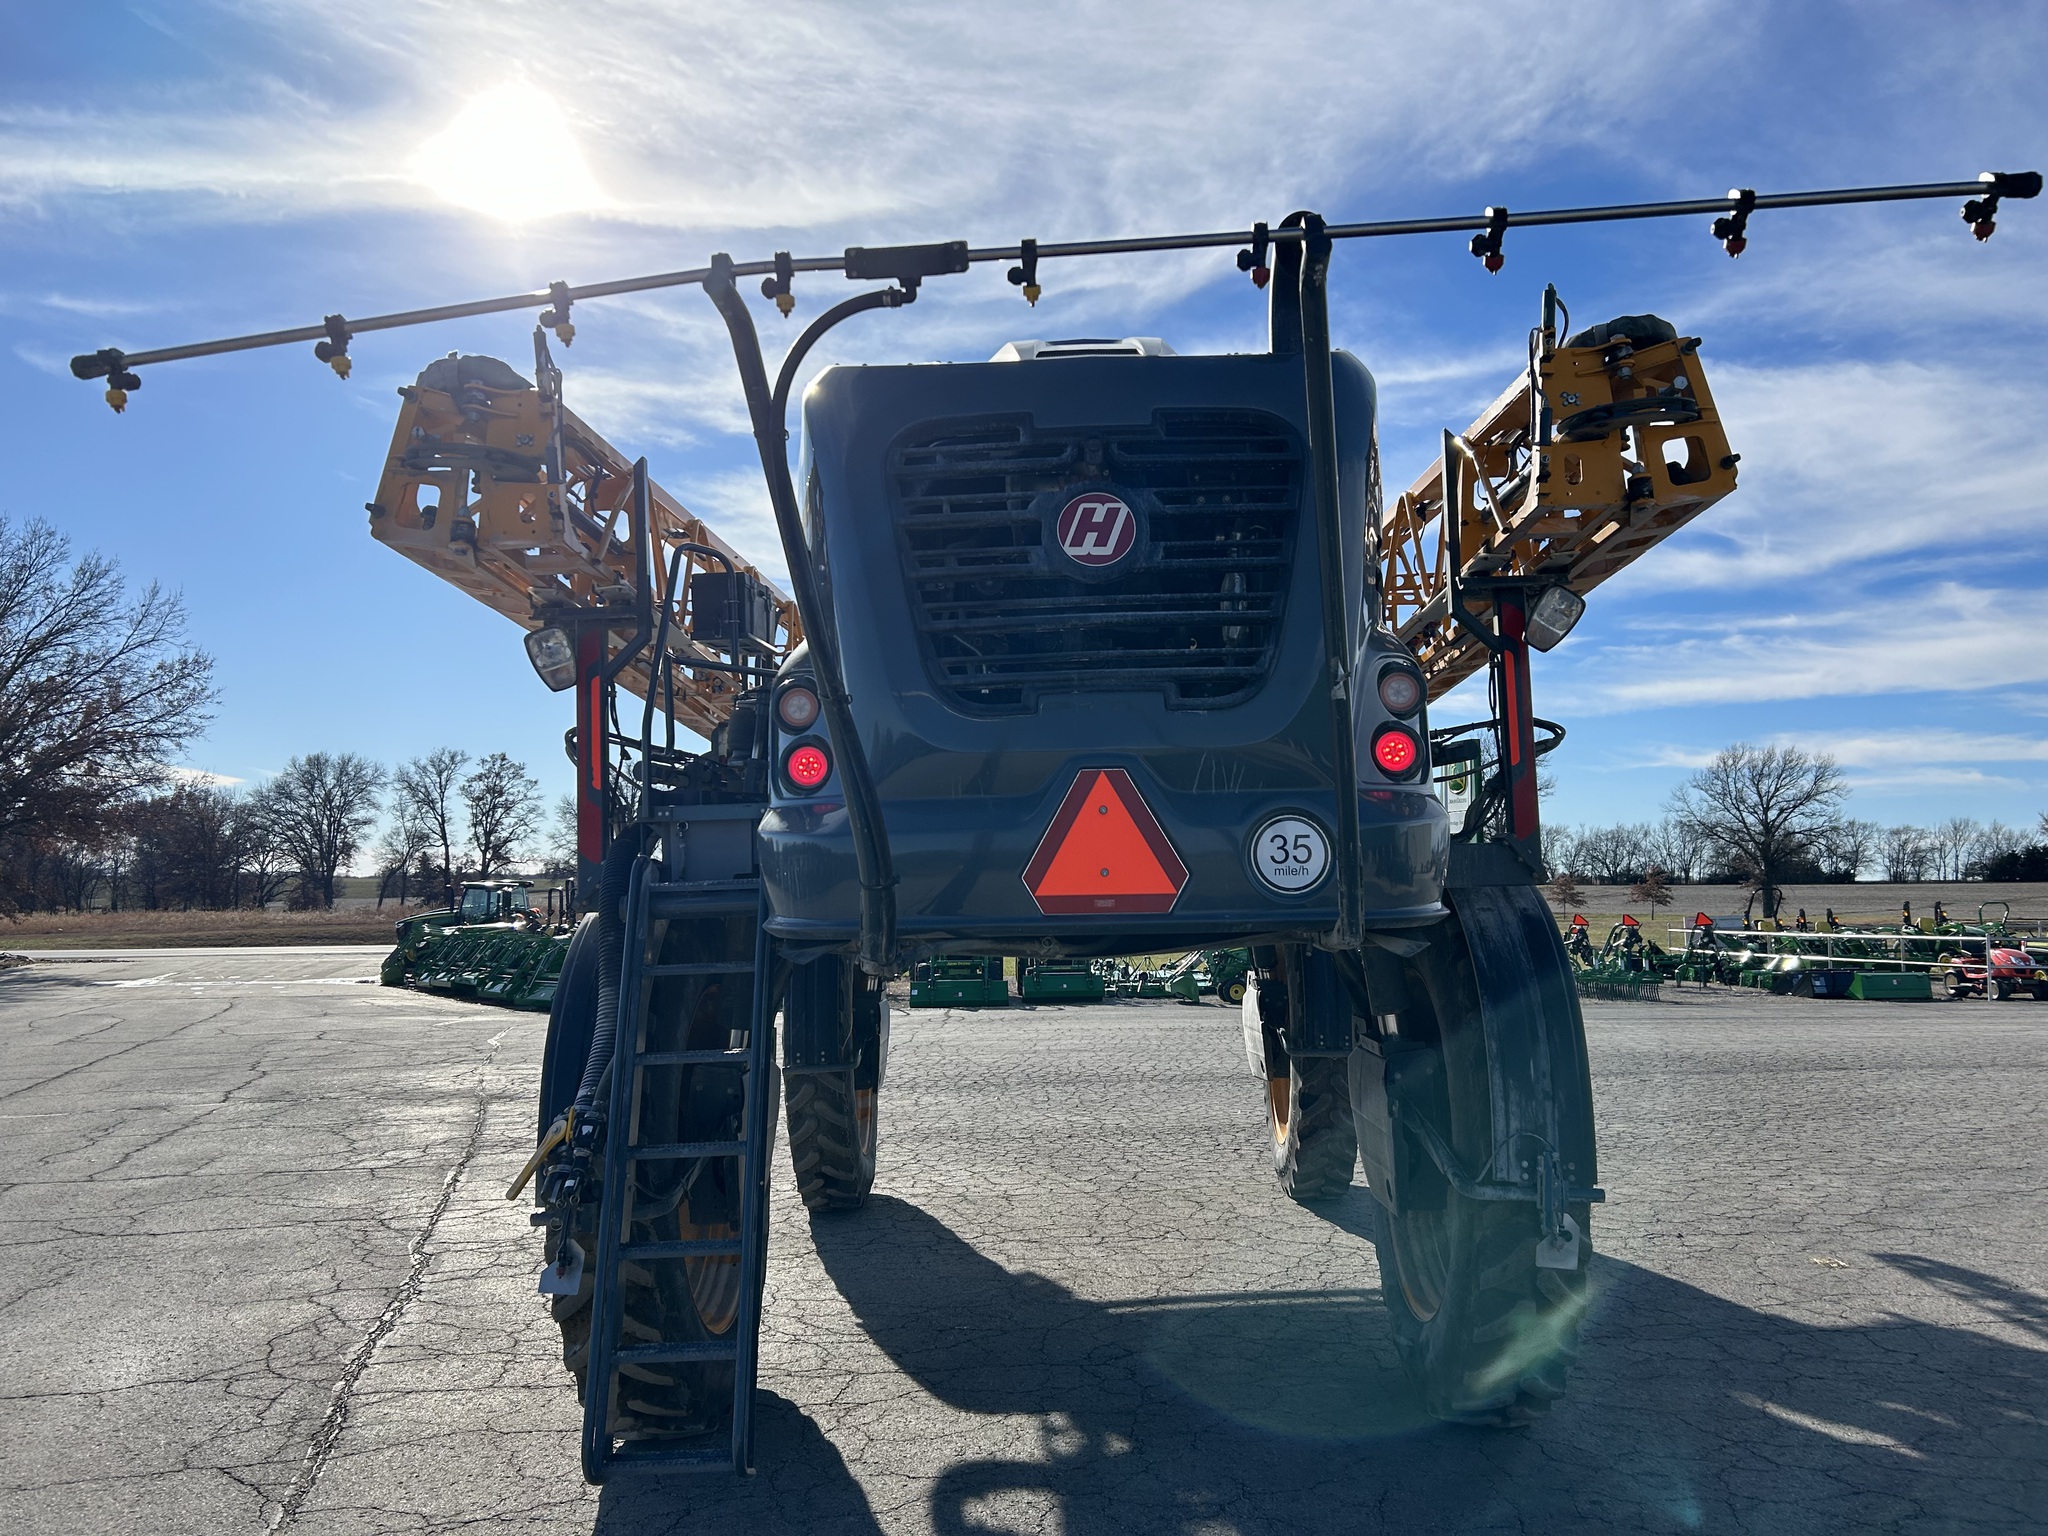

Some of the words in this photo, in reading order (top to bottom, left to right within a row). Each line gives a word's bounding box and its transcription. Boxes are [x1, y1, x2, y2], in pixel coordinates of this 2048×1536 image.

[1064, 503, 1127, 555] H
[1269, 834, 1313, 865] 35
[1274, 866, 1309, 876] mile/h
